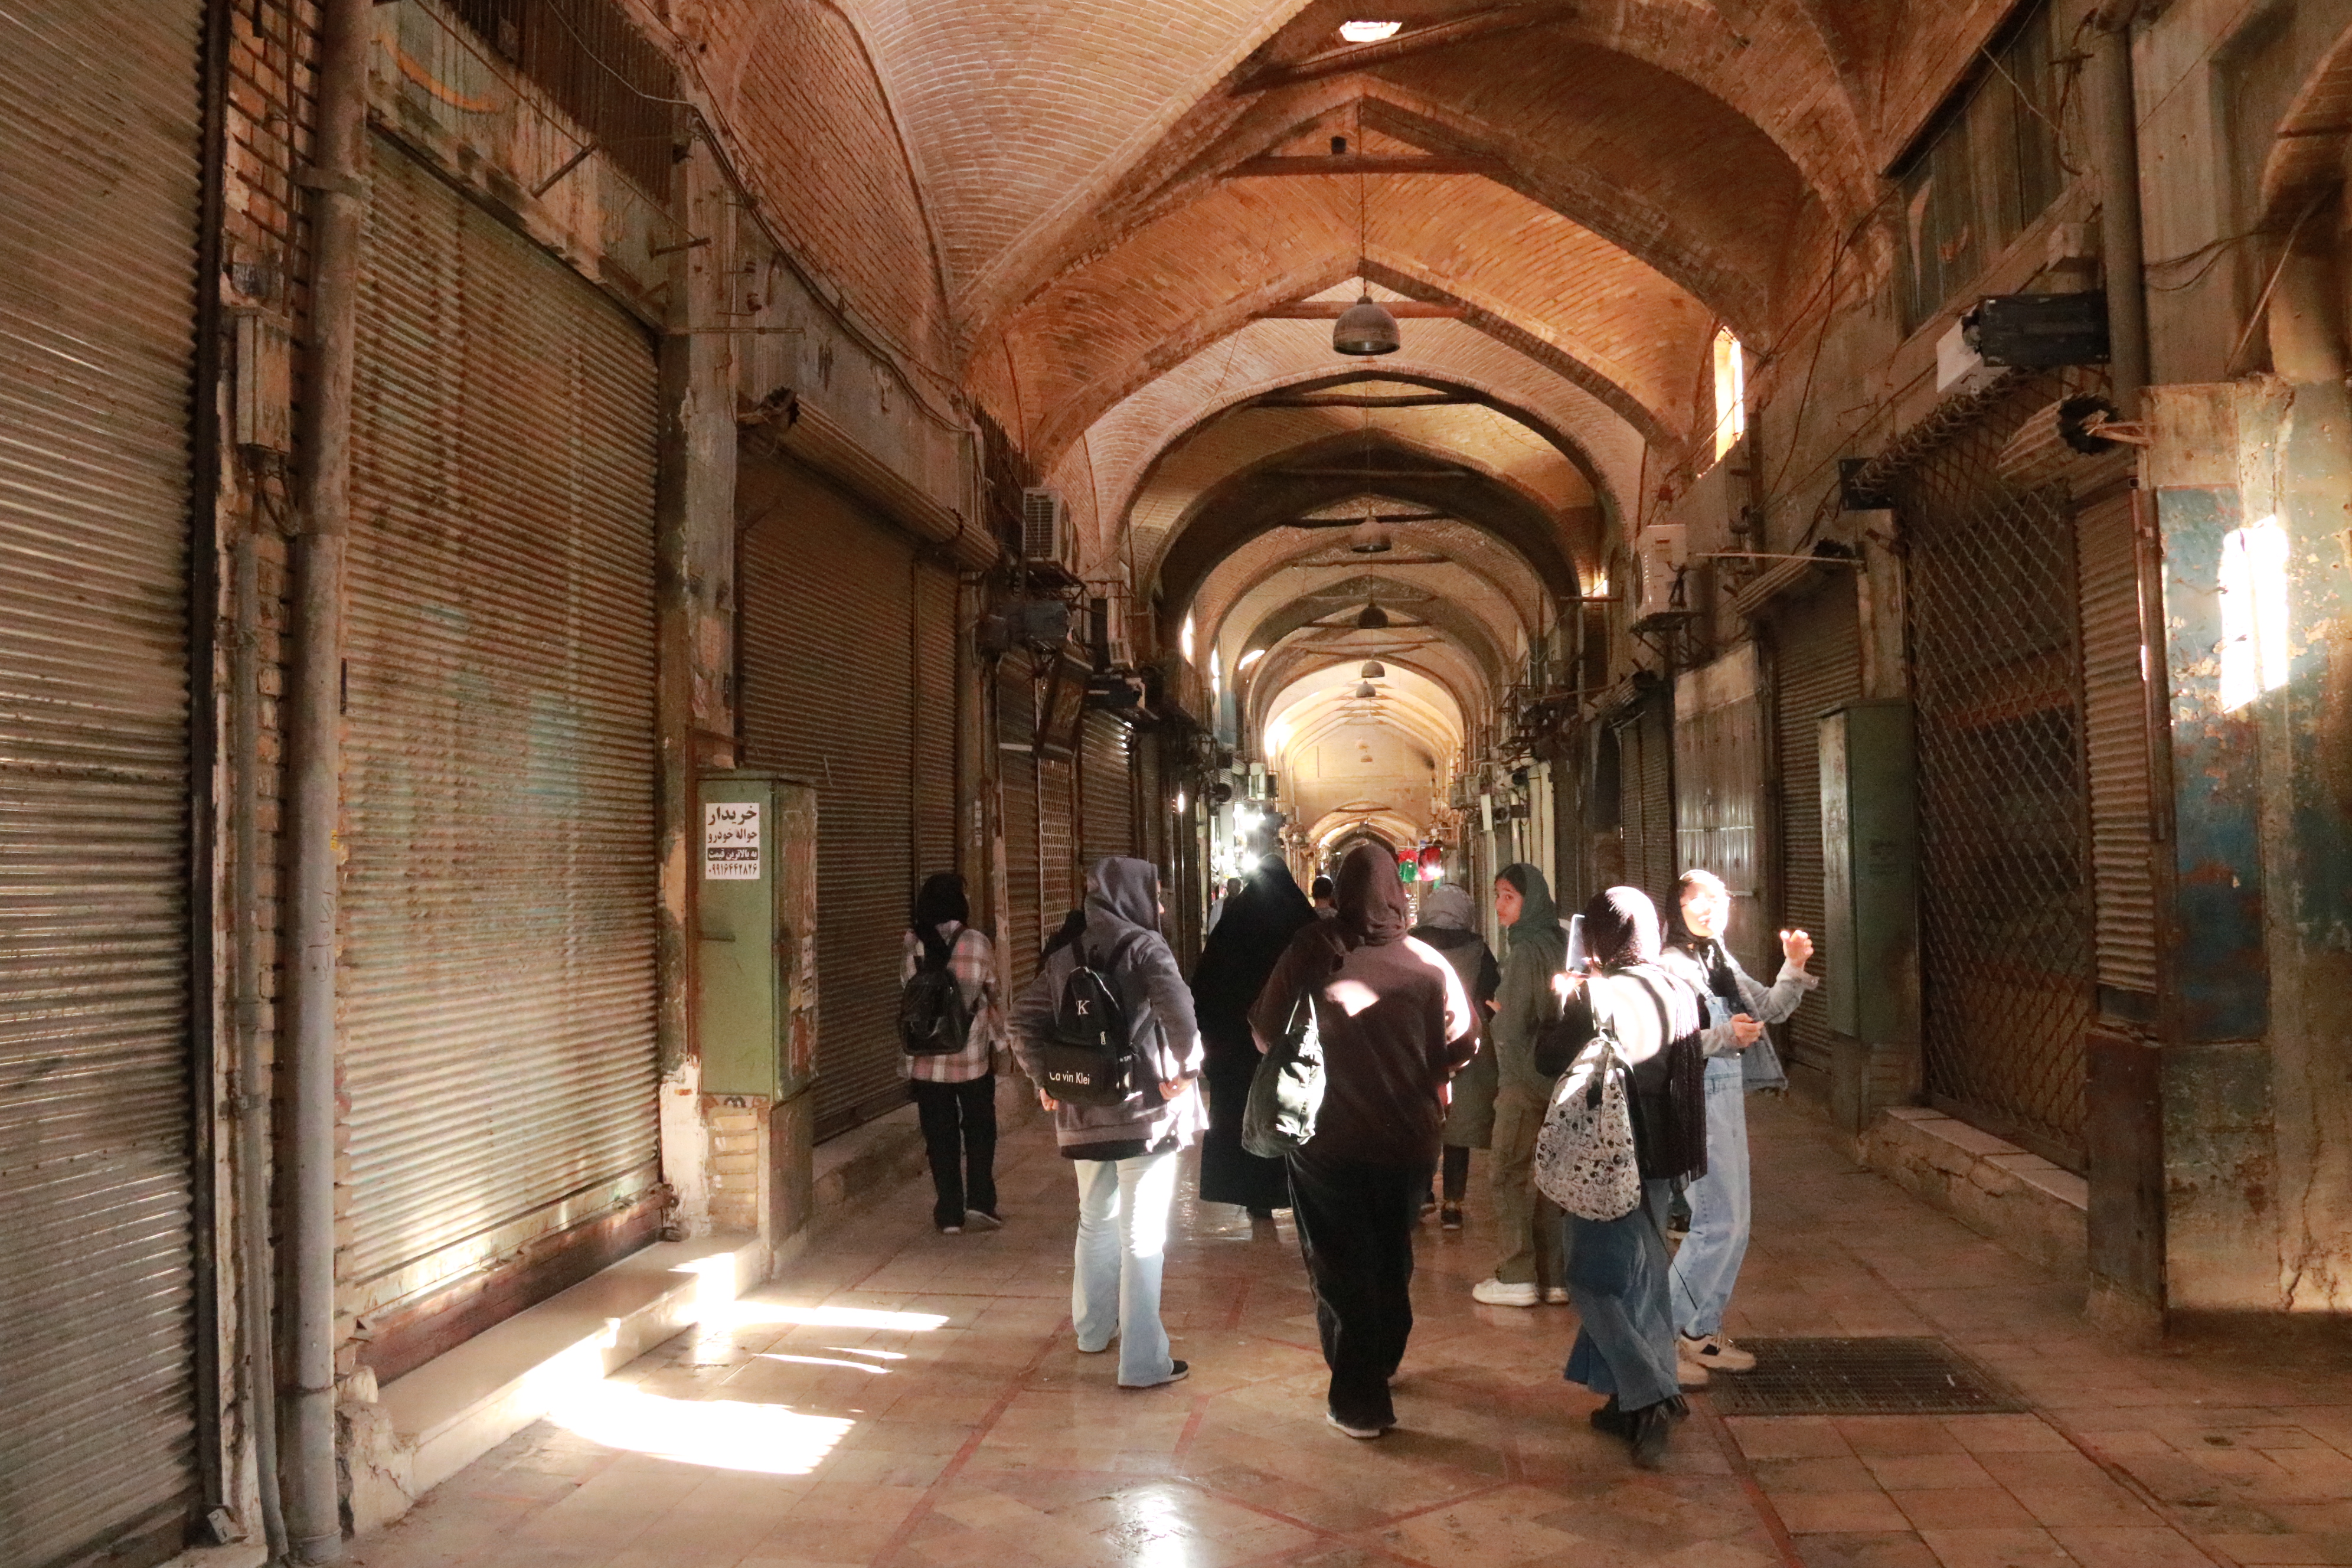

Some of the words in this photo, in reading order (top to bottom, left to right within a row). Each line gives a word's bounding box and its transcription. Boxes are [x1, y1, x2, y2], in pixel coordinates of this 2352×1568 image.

[708, 805, 757, 825] خریدار
[708, 828, 733, 844] خودرو
[736, 828, 757, 843] حواله
[708, 848, 725, 860] قیمت
[726, 849, 750, 860] بالاترین
[750, 850, 757, 860] به
